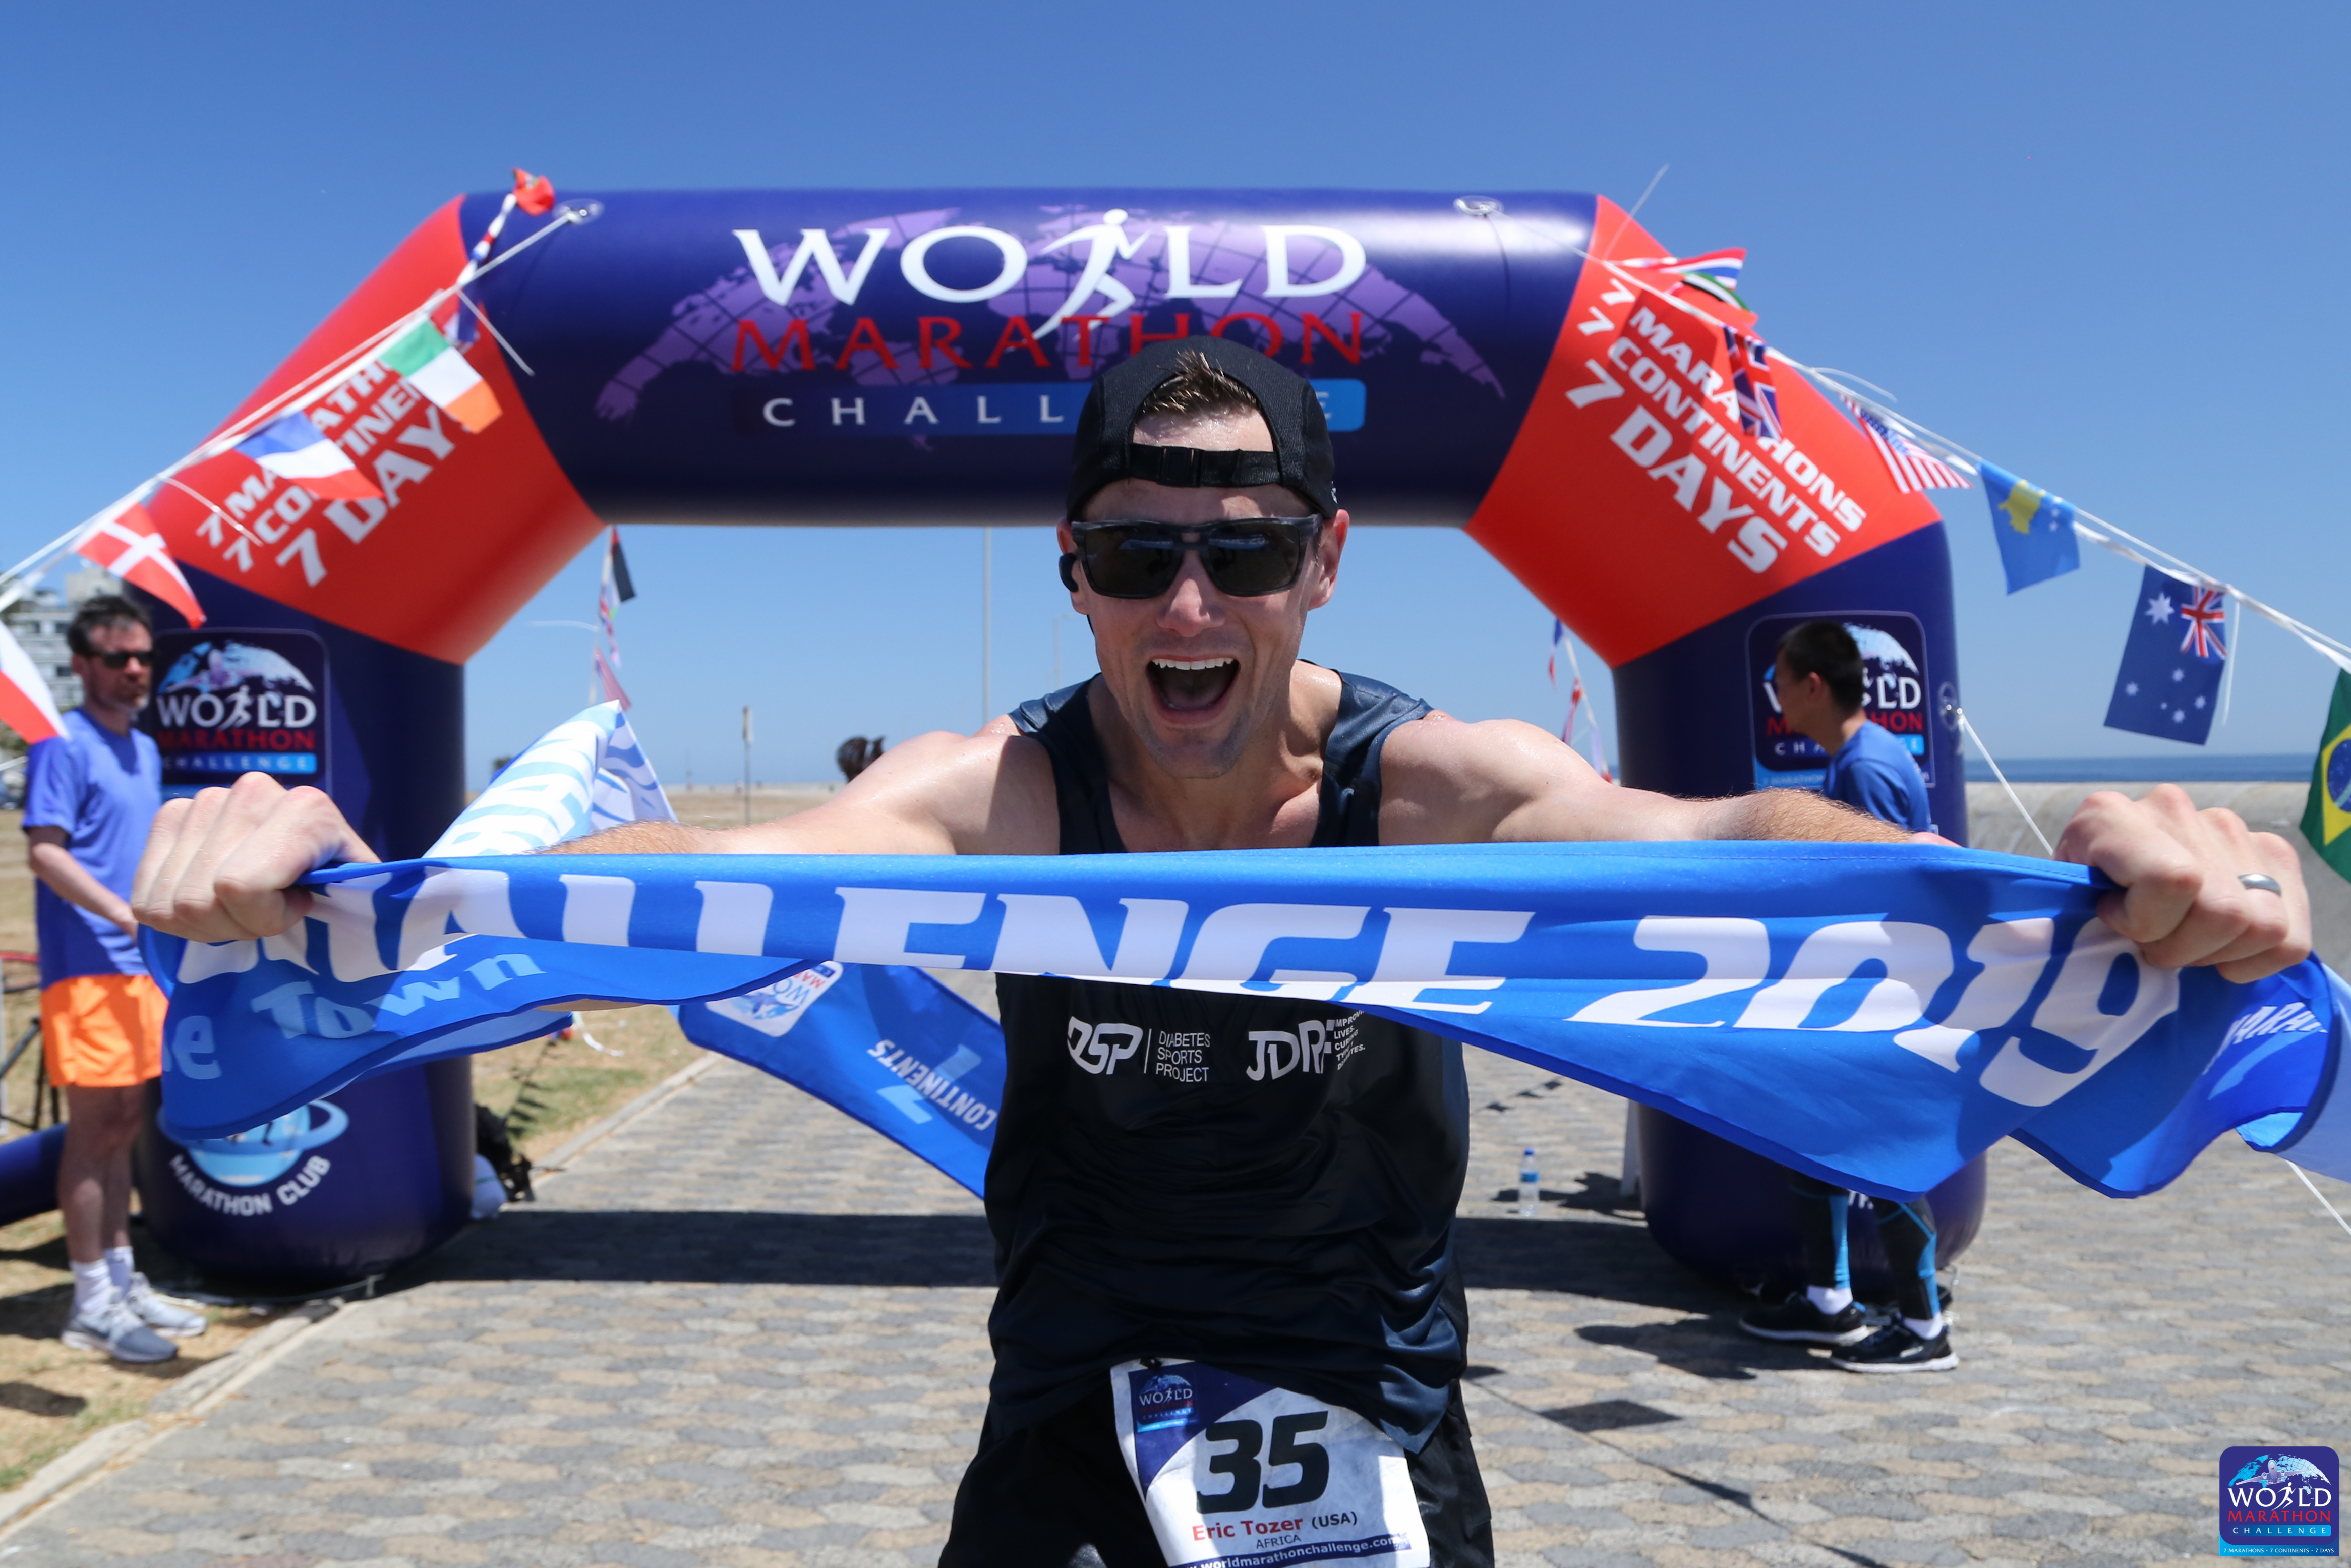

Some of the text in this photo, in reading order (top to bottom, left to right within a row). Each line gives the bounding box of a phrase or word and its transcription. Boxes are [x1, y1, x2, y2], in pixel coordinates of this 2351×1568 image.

[731, 312, 1364, 371] MARATHON
[762, 391, 1332, 427] CHALL
[1577, 306, 1841, 557] 7 CONTINENTS
[1629, 306, 1867, 532] MARAHONS
[275, 402, 456, 587] 7 DAY
[1565, 358, 1789, 574] 7 DAYS
[196, 511, 224, 548] 7
[223, 536, 253, 573] 7
[250, 952, 547, 1039] Town
[1566, 914, 2180, 1107] 2019
[1157, 1046, 1203, 1065] SPORTS
[1158, 1030, 1210, 1048] DIABETES
[866, 1039, 997, 1131] CONTINENTS
[1155, 1063, 1209, 1082] PROJECT
[169, 1154, 331, 1216] MARATHON CLUB
[1196, 1410, 1330, 1515] 35
[1192, 1511, 1358, 1541] Eric Tozer (USA)
[1256, 1534, 1302, 1549] AFRICA
